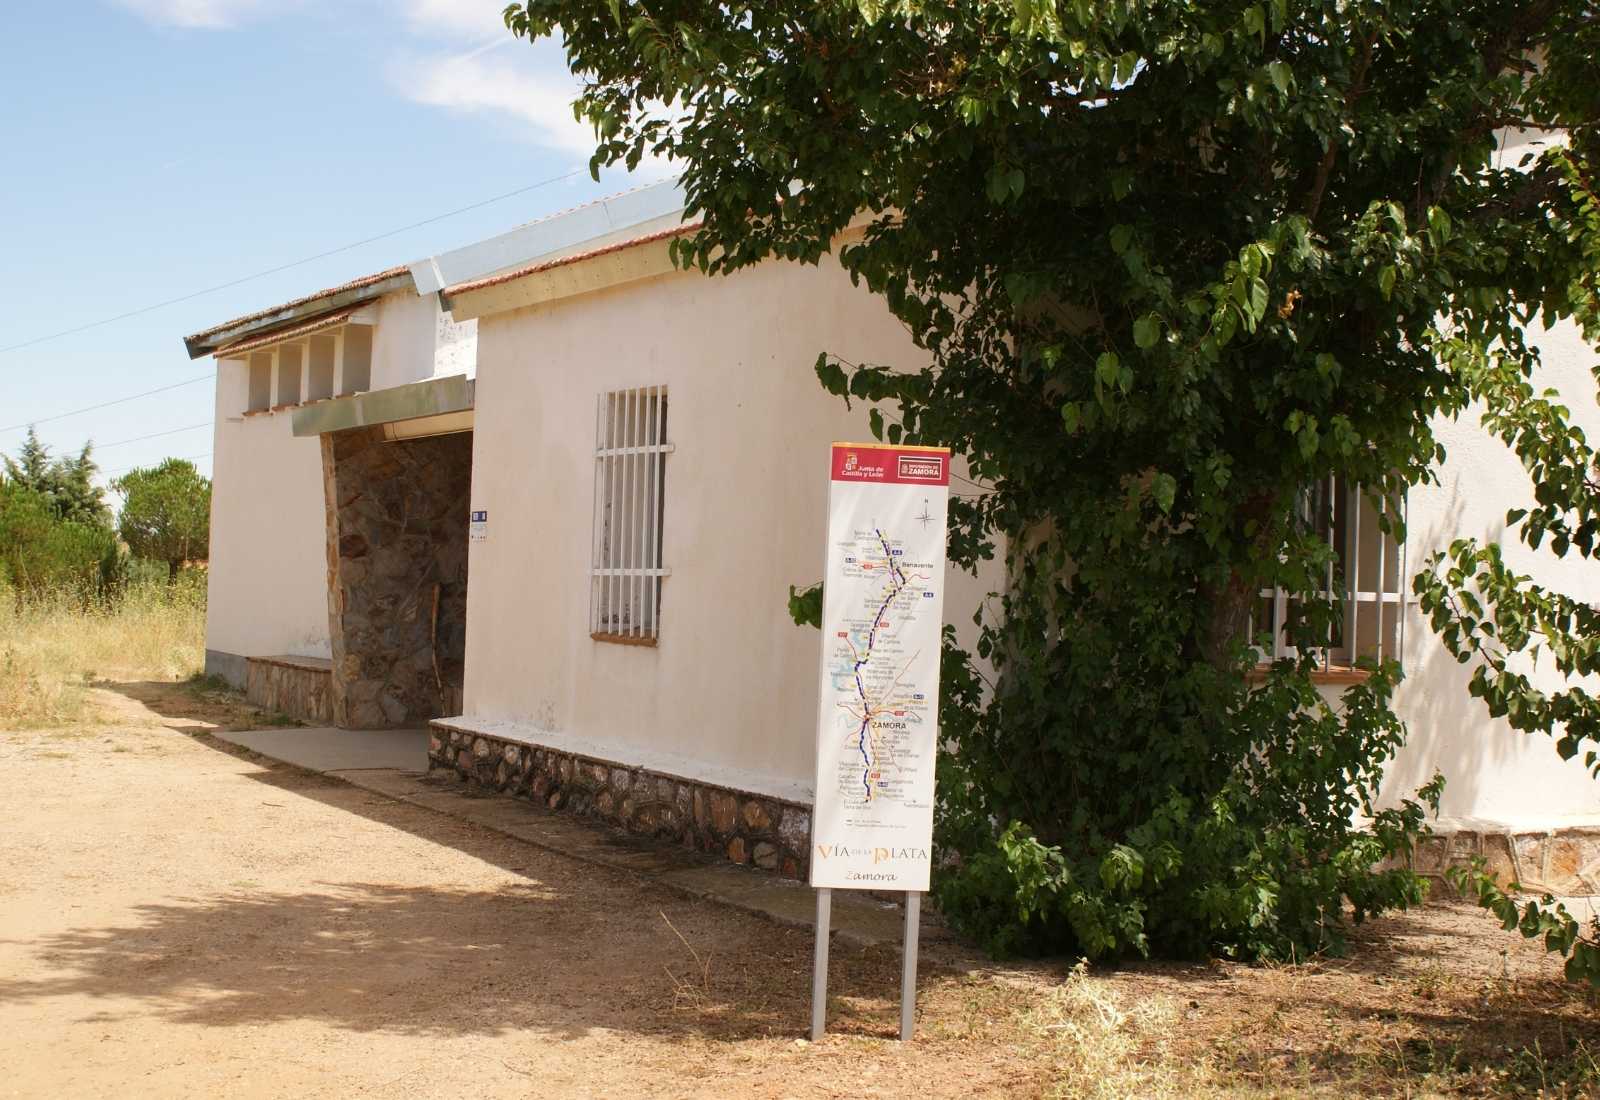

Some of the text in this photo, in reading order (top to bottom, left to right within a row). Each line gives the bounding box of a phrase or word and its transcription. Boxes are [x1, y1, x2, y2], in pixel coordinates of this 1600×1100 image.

[908, 467, 939, 476] ZAMORA
[872, 721, 906, 730] ZAMORA
[818, 842, 850, 859] VÍA
[874, 847, 928, 864] PLATA
[846, 870, 898, 881] Zamora
